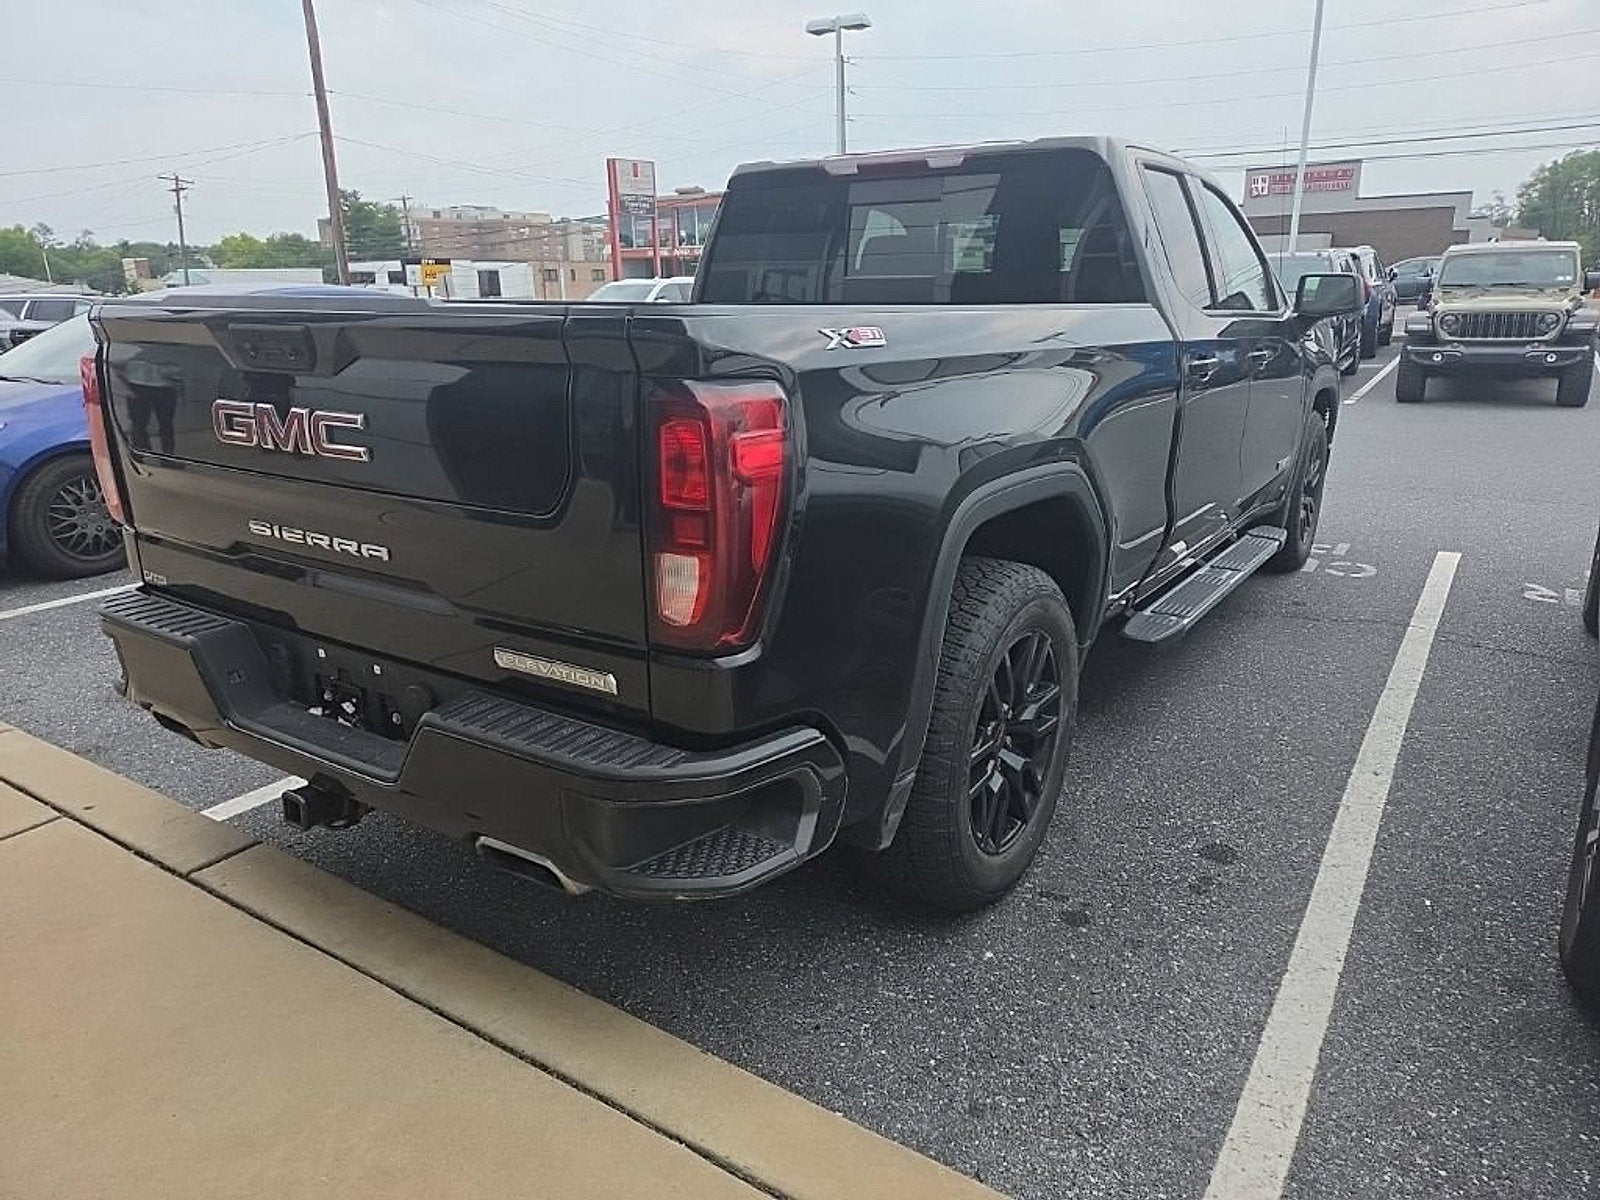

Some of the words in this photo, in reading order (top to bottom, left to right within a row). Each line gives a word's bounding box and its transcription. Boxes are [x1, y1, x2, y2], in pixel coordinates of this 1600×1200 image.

[212, 399, 375, 463] GMC
[248, 519, 391, 562] SIERRA
[500, 653, 608, 689] ELEVATION
